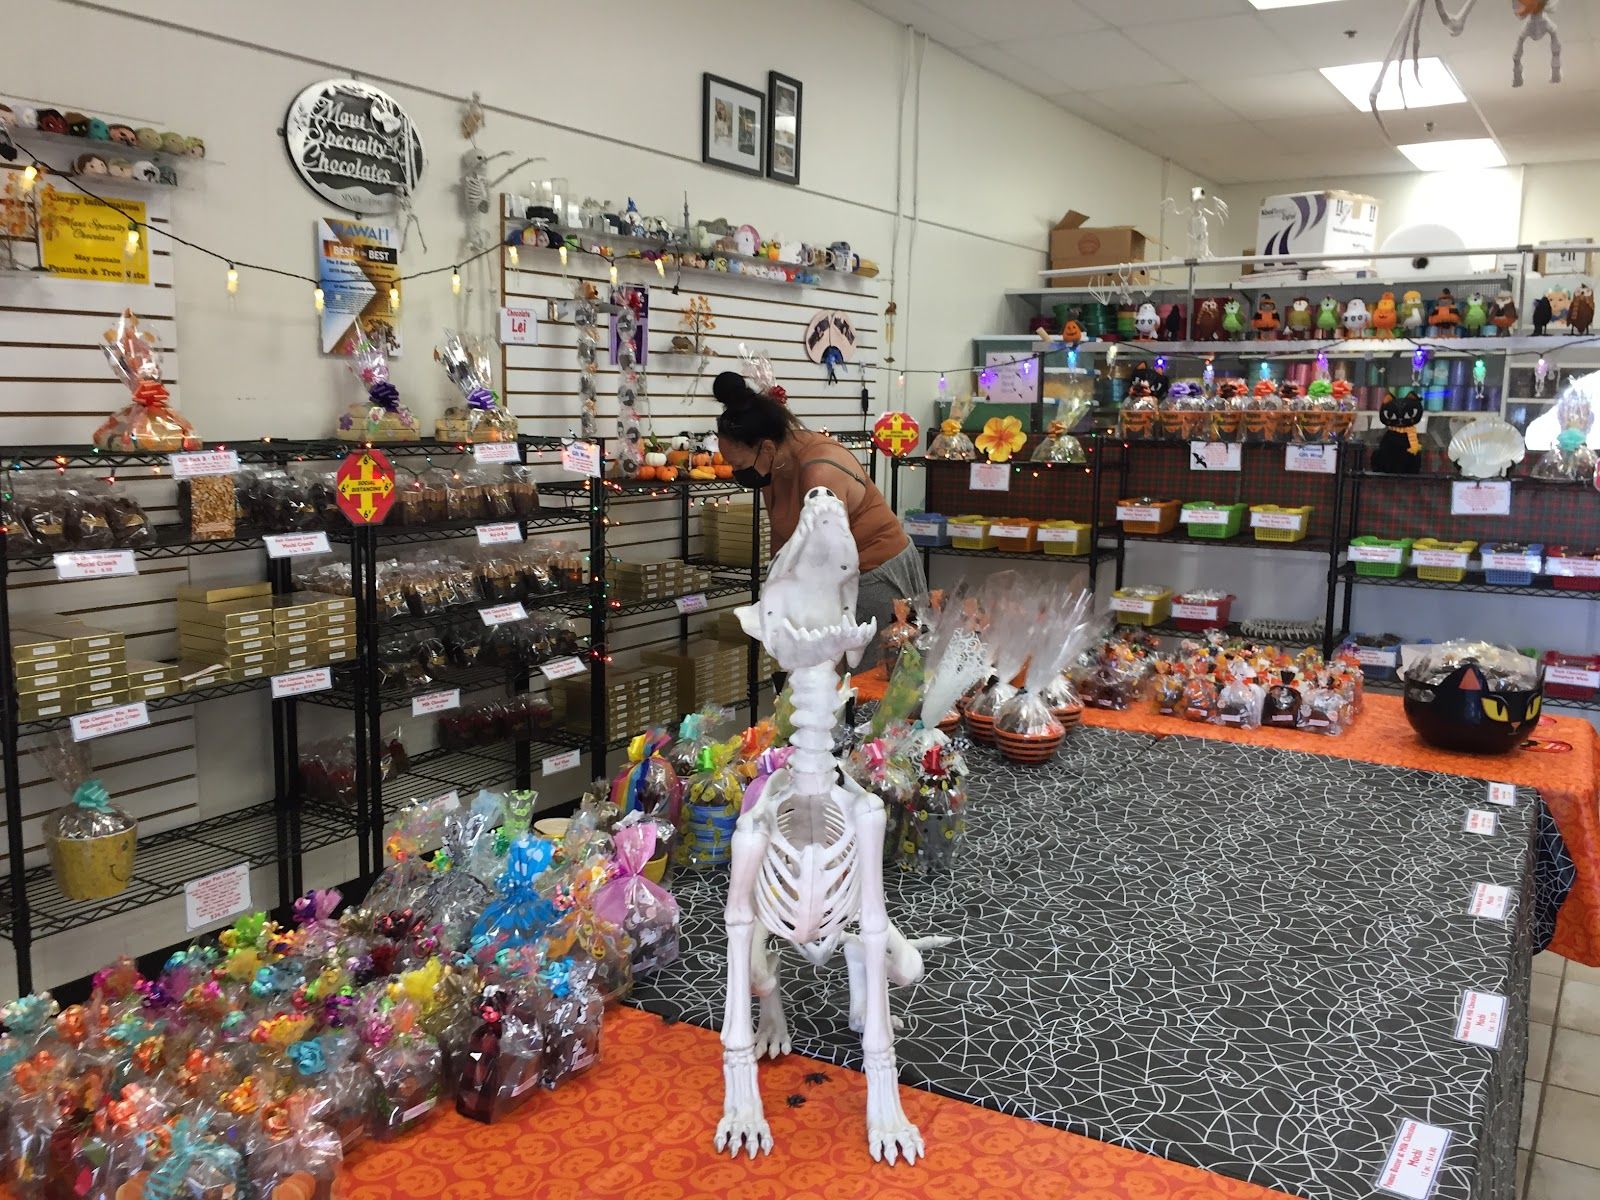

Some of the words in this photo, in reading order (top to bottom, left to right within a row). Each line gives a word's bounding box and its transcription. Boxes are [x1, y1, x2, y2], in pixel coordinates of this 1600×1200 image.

[311, 97, 366, 130] Maui
[306, 119, 388, 158] Specialty
[303, 141, 391, 181] Chocolates
[74, 254, 91, 262] May
[334, 246, 355, 256] BEST
[368, 249, 389, 261] BEST
[102, 268, 122, 278] Tree
[512, 319, 526, 333] Lei
[1390, 1160, 1402, 1173] Butter
[1398, 1144, 1408, 1153] Milk
[1403, 1123, 1417, 1142] Chocolate
[1408, 1148, 1422, 1167] Mochi
